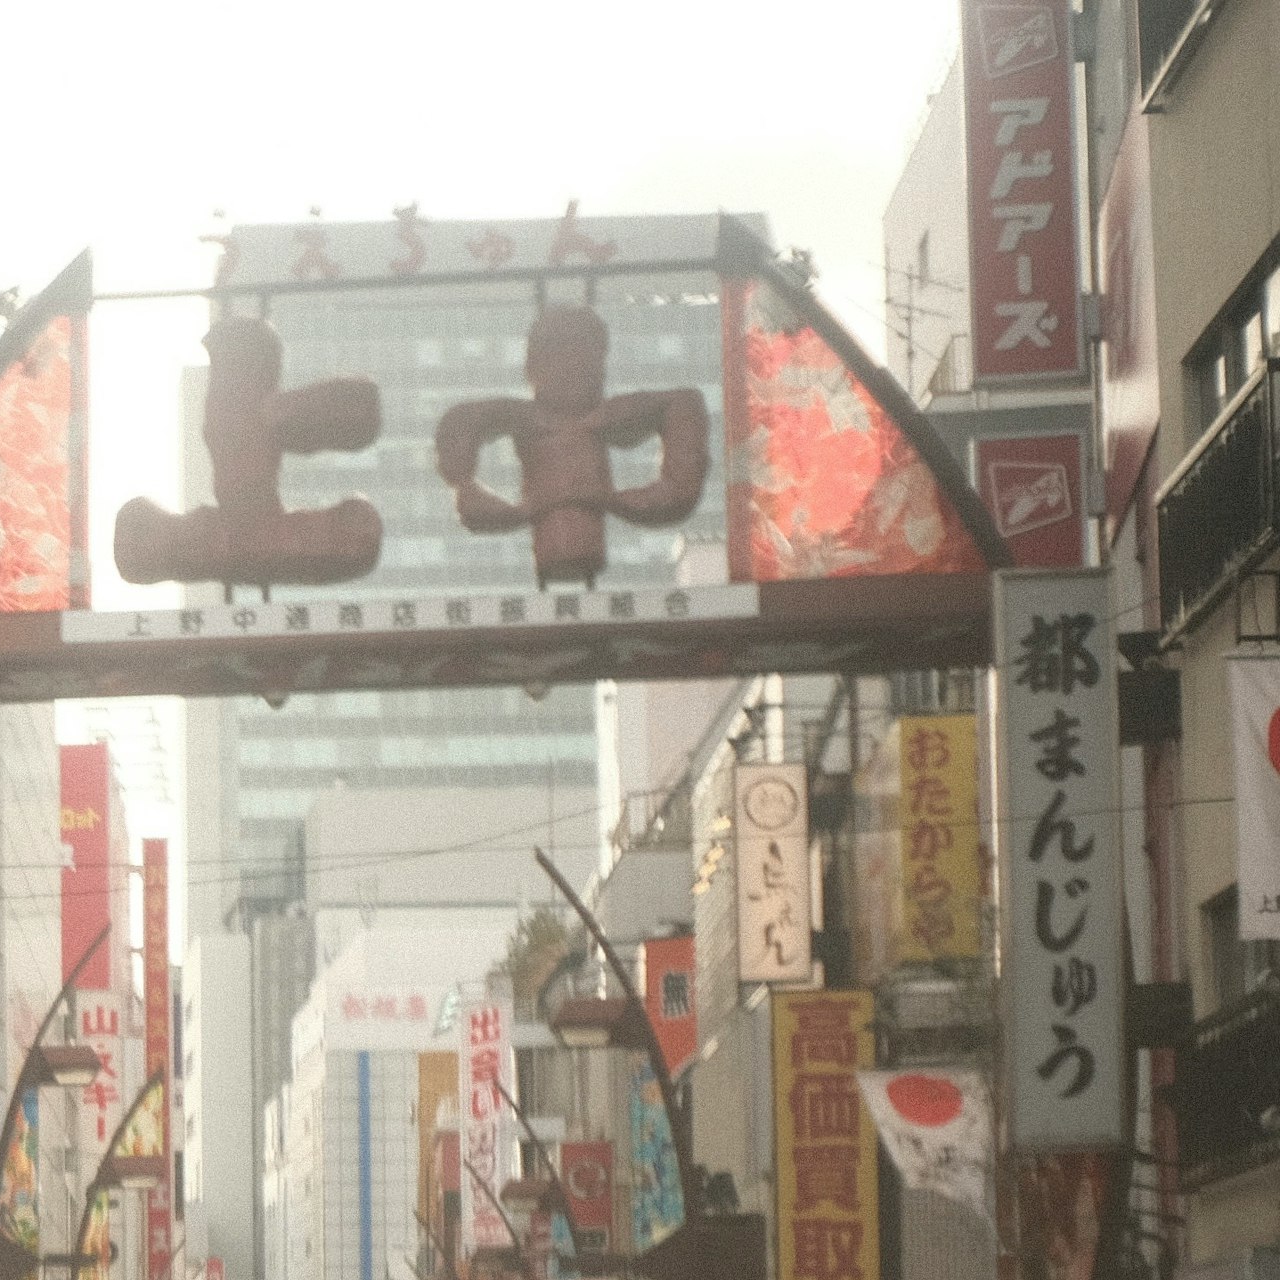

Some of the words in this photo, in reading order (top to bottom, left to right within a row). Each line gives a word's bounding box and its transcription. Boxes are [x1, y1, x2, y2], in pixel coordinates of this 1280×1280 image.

[989, 97, 1062, 353] アドアーズ
[114, 303, 709, 586] 上中
[1016, 612, 1100, 1099] 都まんじゅう
